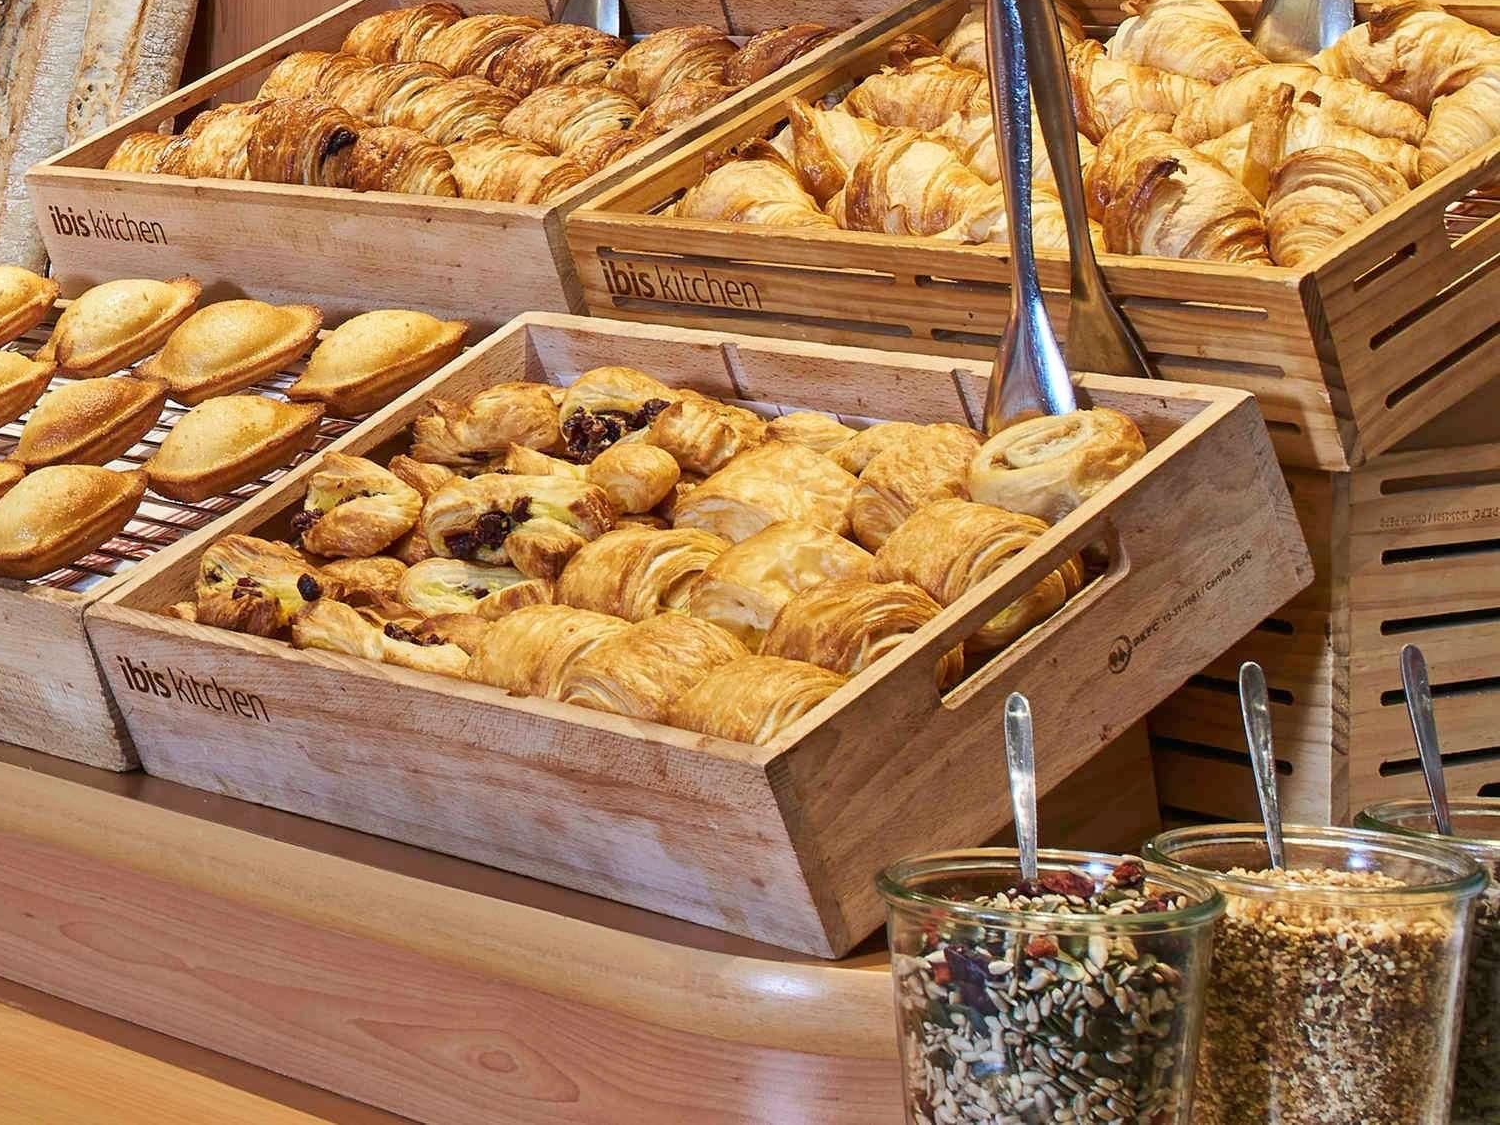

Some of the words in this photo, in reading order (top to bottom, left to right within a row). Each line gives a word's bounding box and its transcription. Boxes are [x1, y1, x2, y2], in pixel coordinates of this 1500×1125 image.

[47, 204, 91, 237] ibis
[88, 208, 168, 246] kitchen
[599, 259, 656, 299] ibis
[654, 264, 763, 309] kitchen
[115, 654, 172, 699] ibis
[166, 666, 271, 723] kitchen
